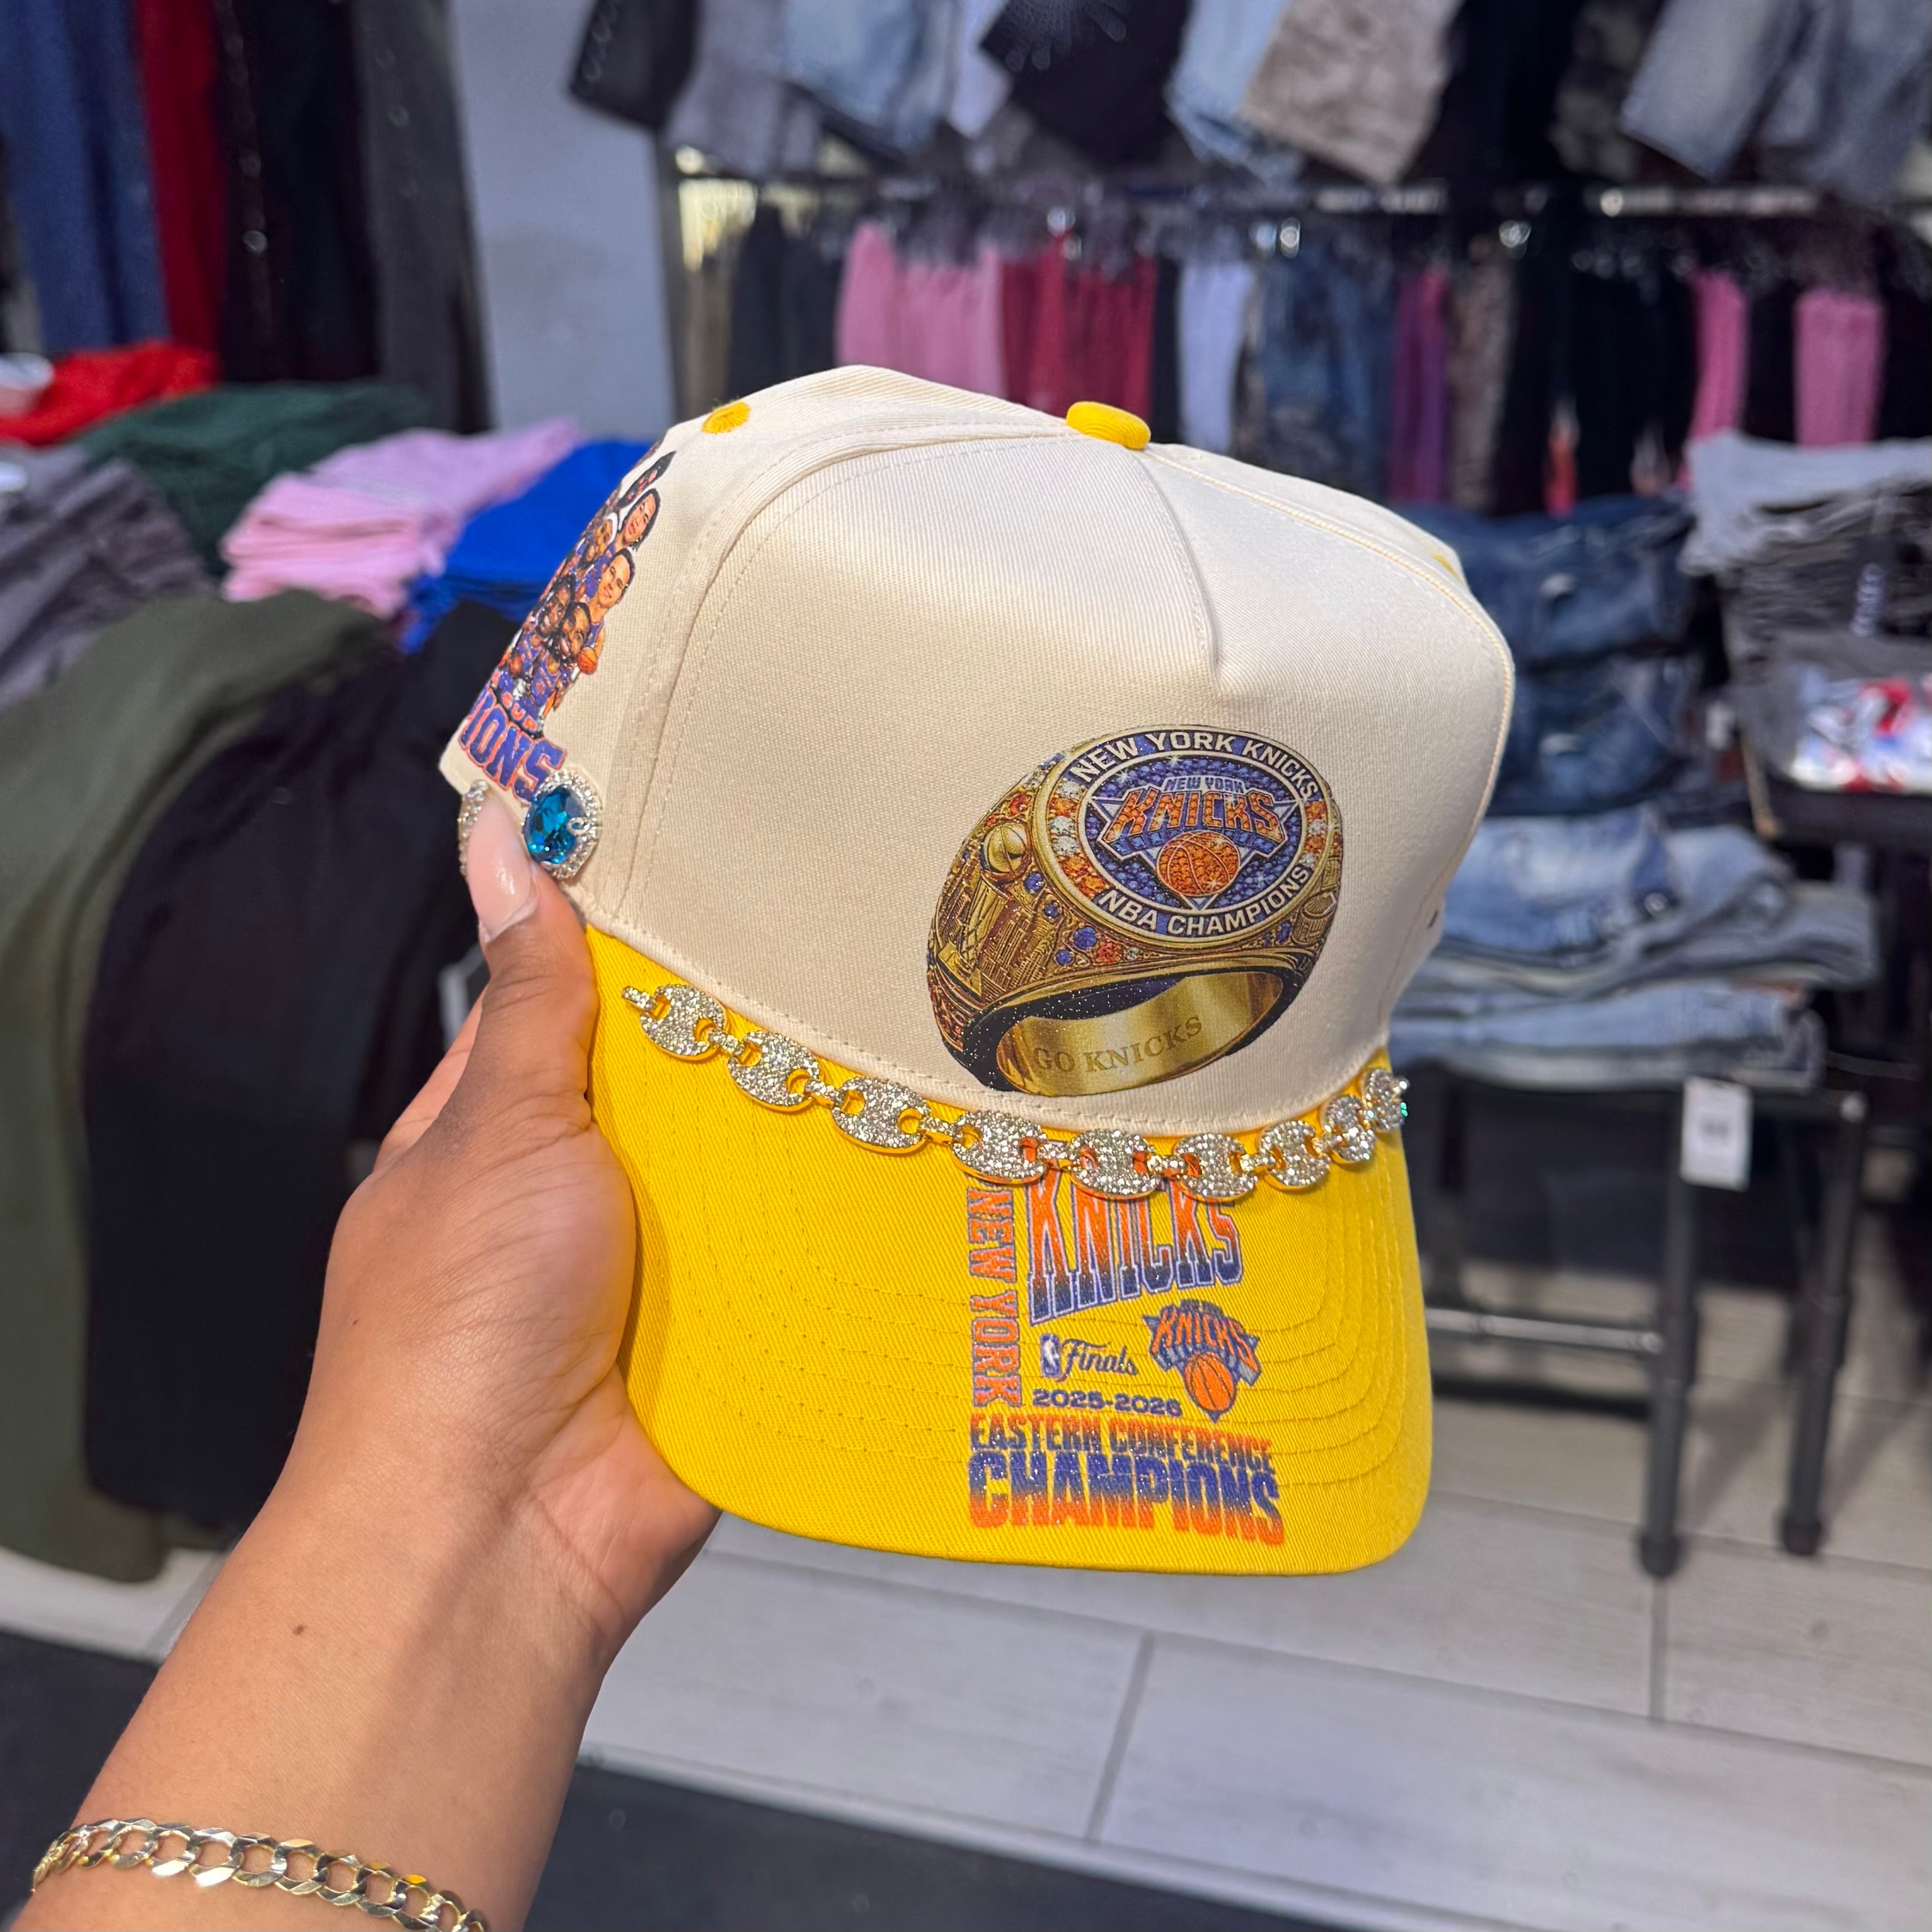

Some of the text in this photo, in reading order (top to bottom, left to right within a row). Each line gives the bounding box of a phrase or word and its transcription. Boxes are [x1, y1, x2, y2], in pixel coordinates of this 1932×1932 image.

[1070, 731, 1319, 800] NEW YORK KNICKS
[1164, 777, 1245, 794] NEW YORK
[1102, 786, 1287, 844] KNICKS
[1097, 866, 1310, 936] NBA CHAMPIONS
[1032, 1014, 1203, 1073] GO KNICKS
[1023, 1167, 1245, 1326] KNICKS
[966, 1186, 1022, 1408] NEW YORK
[1055, 1338, 1139, 1382] Finals
[1150, 1306, 1260, 1377] KNICKS
[1032, 1388, 1184, 1418] 2025-2026
[969, 1413, 1277, 1476] EASTERN CONFERENCE
[968, 1450, 1285, 1546] CHAMPIONS
